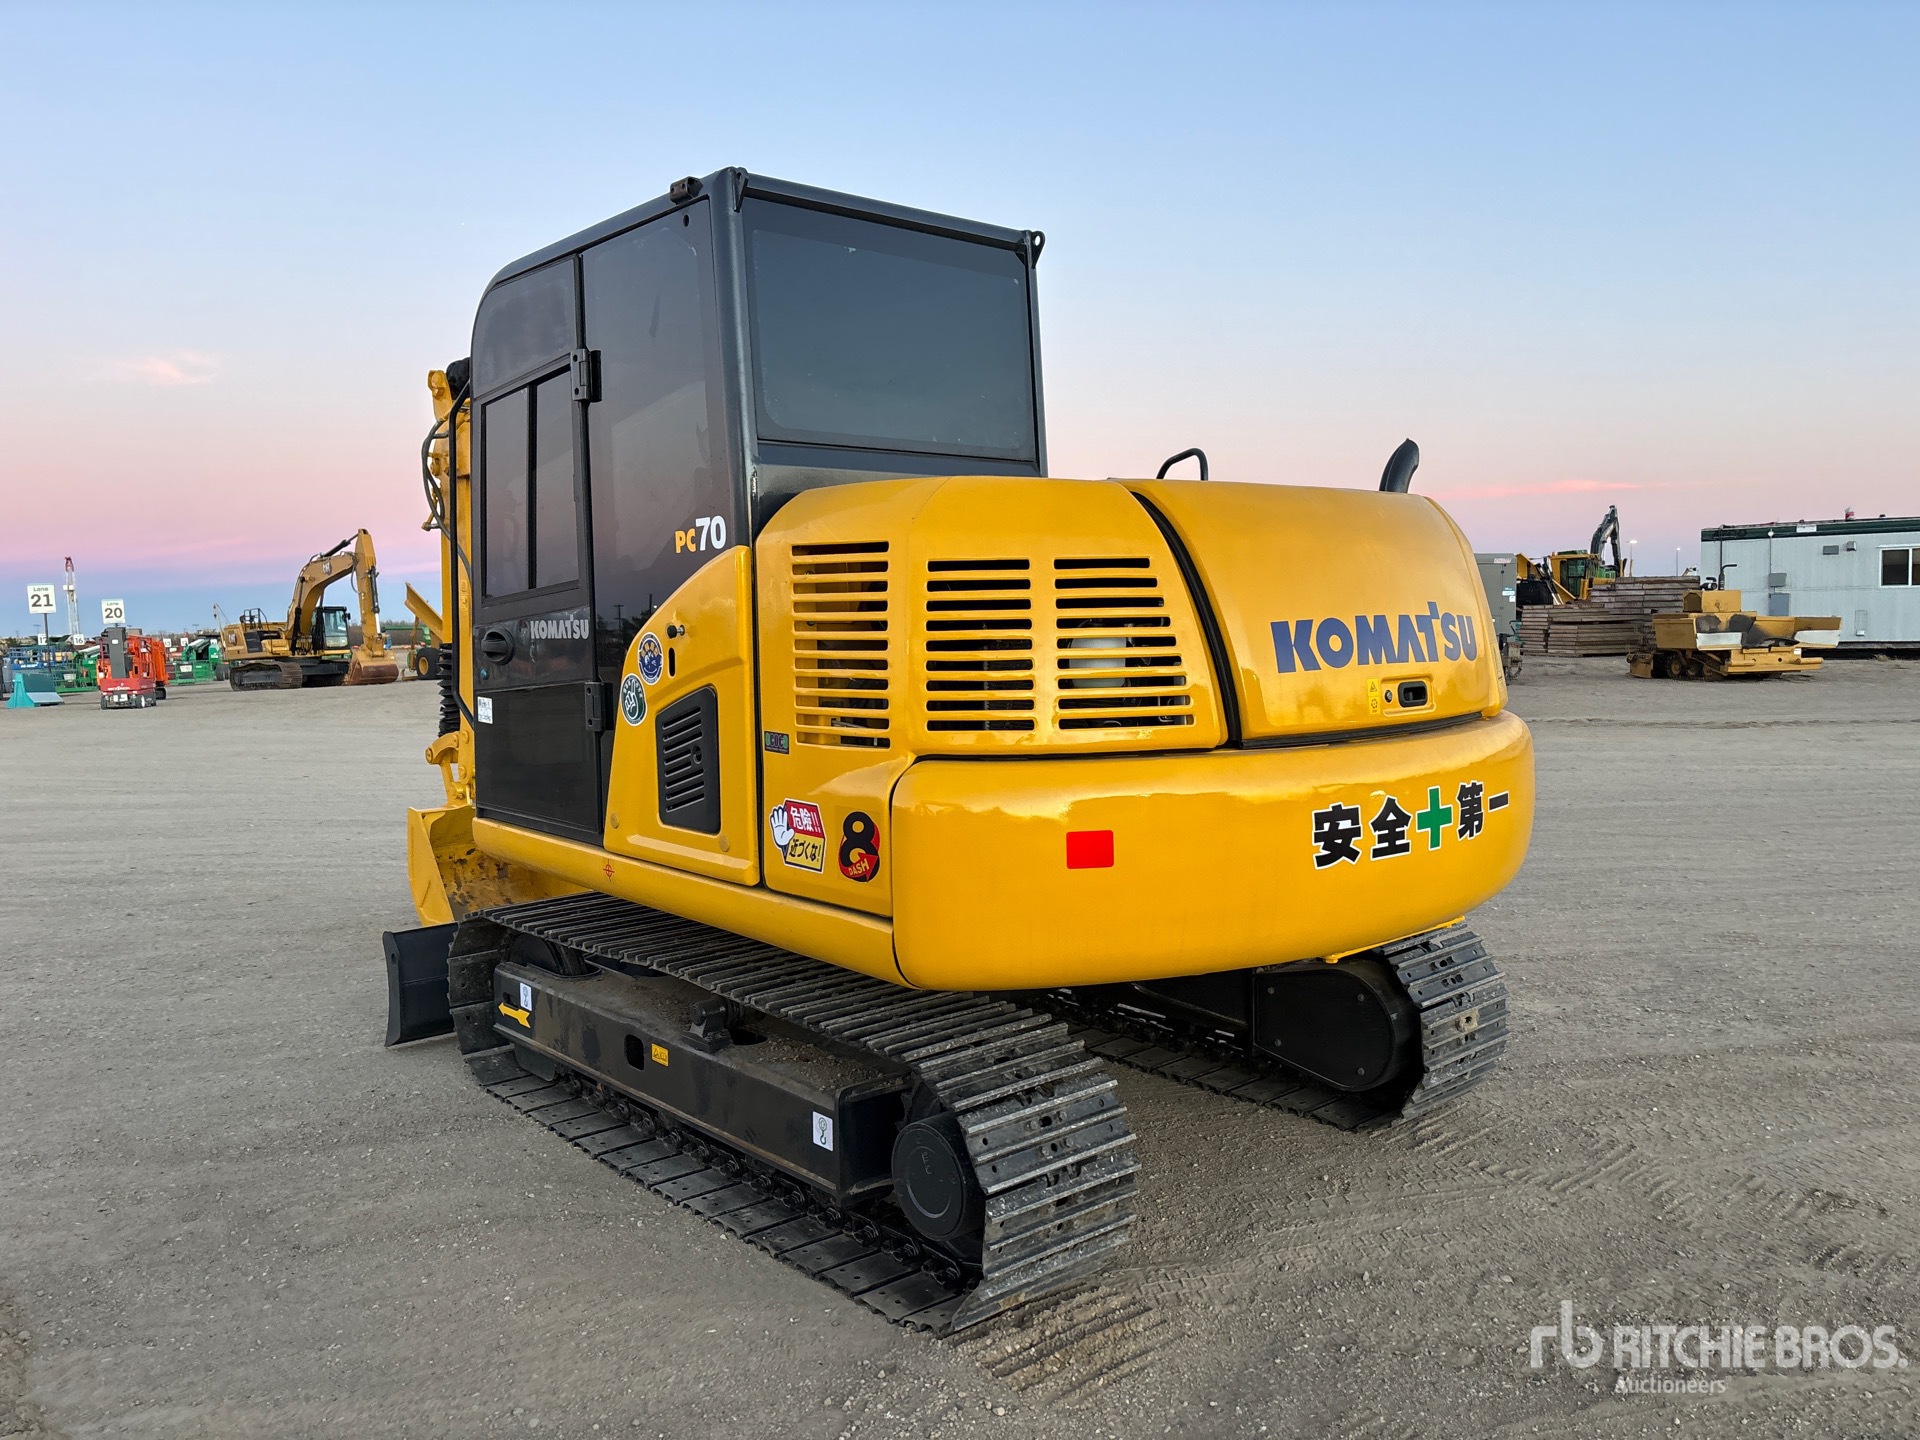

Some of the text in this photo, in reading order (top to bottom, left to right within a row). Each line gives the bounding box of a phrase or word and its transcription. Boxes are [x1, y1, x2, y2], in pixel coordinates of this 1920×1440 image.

[30, 594, 53, 608] 21
[104, 607, 123, 619] 20
[529, 614, 590, 640] KOMATSU
[1270, 601, 1478, 674] KOMATSU
[840, 811, 880, 883] 8
[848, 858, 870, 876] DASH
